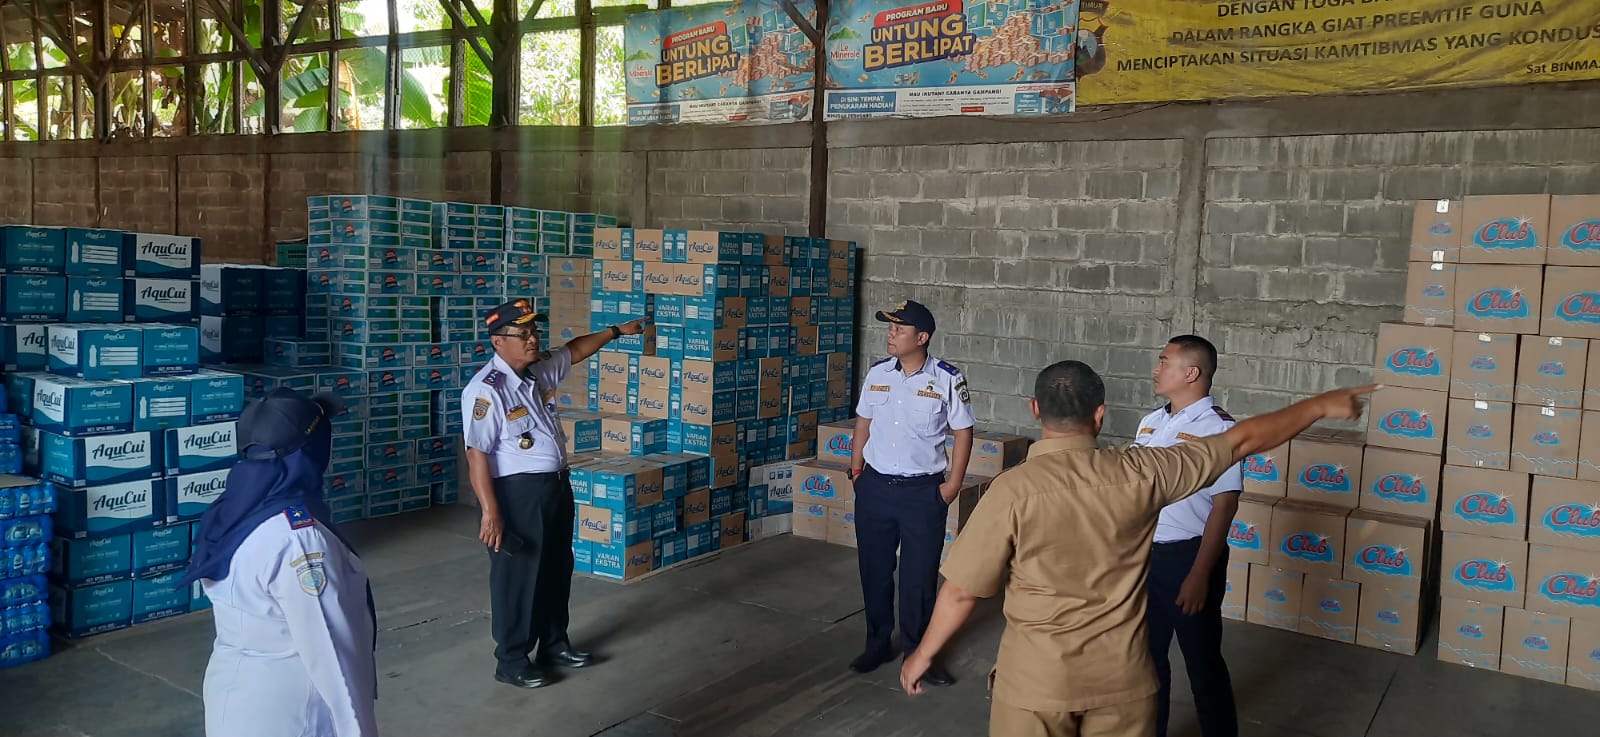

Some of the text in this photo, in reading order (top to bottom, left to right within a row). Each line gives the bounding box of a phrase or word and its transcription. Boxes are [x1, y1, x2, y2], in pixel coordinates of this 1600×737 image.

[886, 3, 948, 21] PROGRAM BARU
[1217, 0, 1298, 17] DENGAN
[872, 14, 964, 43] UNTUNG
[1172, 1, 1545, 42] DALAM RANGKA GIAT PREEMTIF GUNA
[671, 26, 715, 44] PROGRAM BARU
[662, 35, 729, 62] UNTUNG
[840, 43, 849, 52] Le
[864, 35, 973, 68] BERLIPAT
[1118, 52, 1234, 71] MENCIPTAKAN
[1240, 46, 1308, 63] SITUASI
[1314, 37, 1437, 60] KAMTIBMAS
[1444, 32, 1501, 50] YANG
[656, 53, 738, 86] BERLIPAT
[1527, 60, 1600, 74] Sat BINMA
[1480, 221, 1529, 243] Club
[1570, 223, 1600, 244] Cl
[142, 242, 187, 256] AquCui
[595, 240, 617, 250] AquCui
[635, 240, 659, 251] AquCui
[688, 241, 714, 253] AquCui
[604, 270, 629, 282] AquCui
[645, 273, 669, 285] AquCui
[674, 274, 700, 286] AquCui
[141, 287, 186, 301] AquCui
[1474, 290, 1521, 312] Club
[658, 304, 679, 312] VARIAN
[1564, 294, 1600, 316] Clu
[656, 310, 680, 319] EKSTRA
[51, 335, 75, 351] AquCui
[686, 344, 710, 352] EKSTRA
[1391, 348, 1435, 369] Club
[600, 362, 625, 374] AquCui
[641, 367, 665, 378] AquCui
[683, 371, 709, 383] AquCui
[37, 389, 62, 407] AquCui
[599, 392, 623, 403] AquCui
[639, 398, 664, 410] AquCui
[684, 403, 708, 415] AquCui
[1386, 410, 1428, 430] Club
[184, 430, 232, 449] AquCui
[603, 430, 627, 442] AquCui
[685, 439, 707, 447] EKSTRA
[92, 440, 146, 460] AquCui
[1305, 466, 1345, 484] Club
[571, 486, 588, 494] STRA
[805, 476, 831, 492] Club
[1378, 475, 1421, 495] Club
[94, 490, 146, 511] AquCui
[1461, 495, 1508, 515] Club
[581, 517, 608, 531] AquCui
[1551, 506, 1600, 527] Club
[1228, 525, 1255, 542] lub
[1287, 535, 1327, 554] Club
[595, 559, 621, 569] EKSTRA
[597, 552, 620, 561] VARIAN
[1361, 546, 1405, 567] Club
[1460, 561, 1507, 581] Club
[1548, 575, 1598, 597] Club
